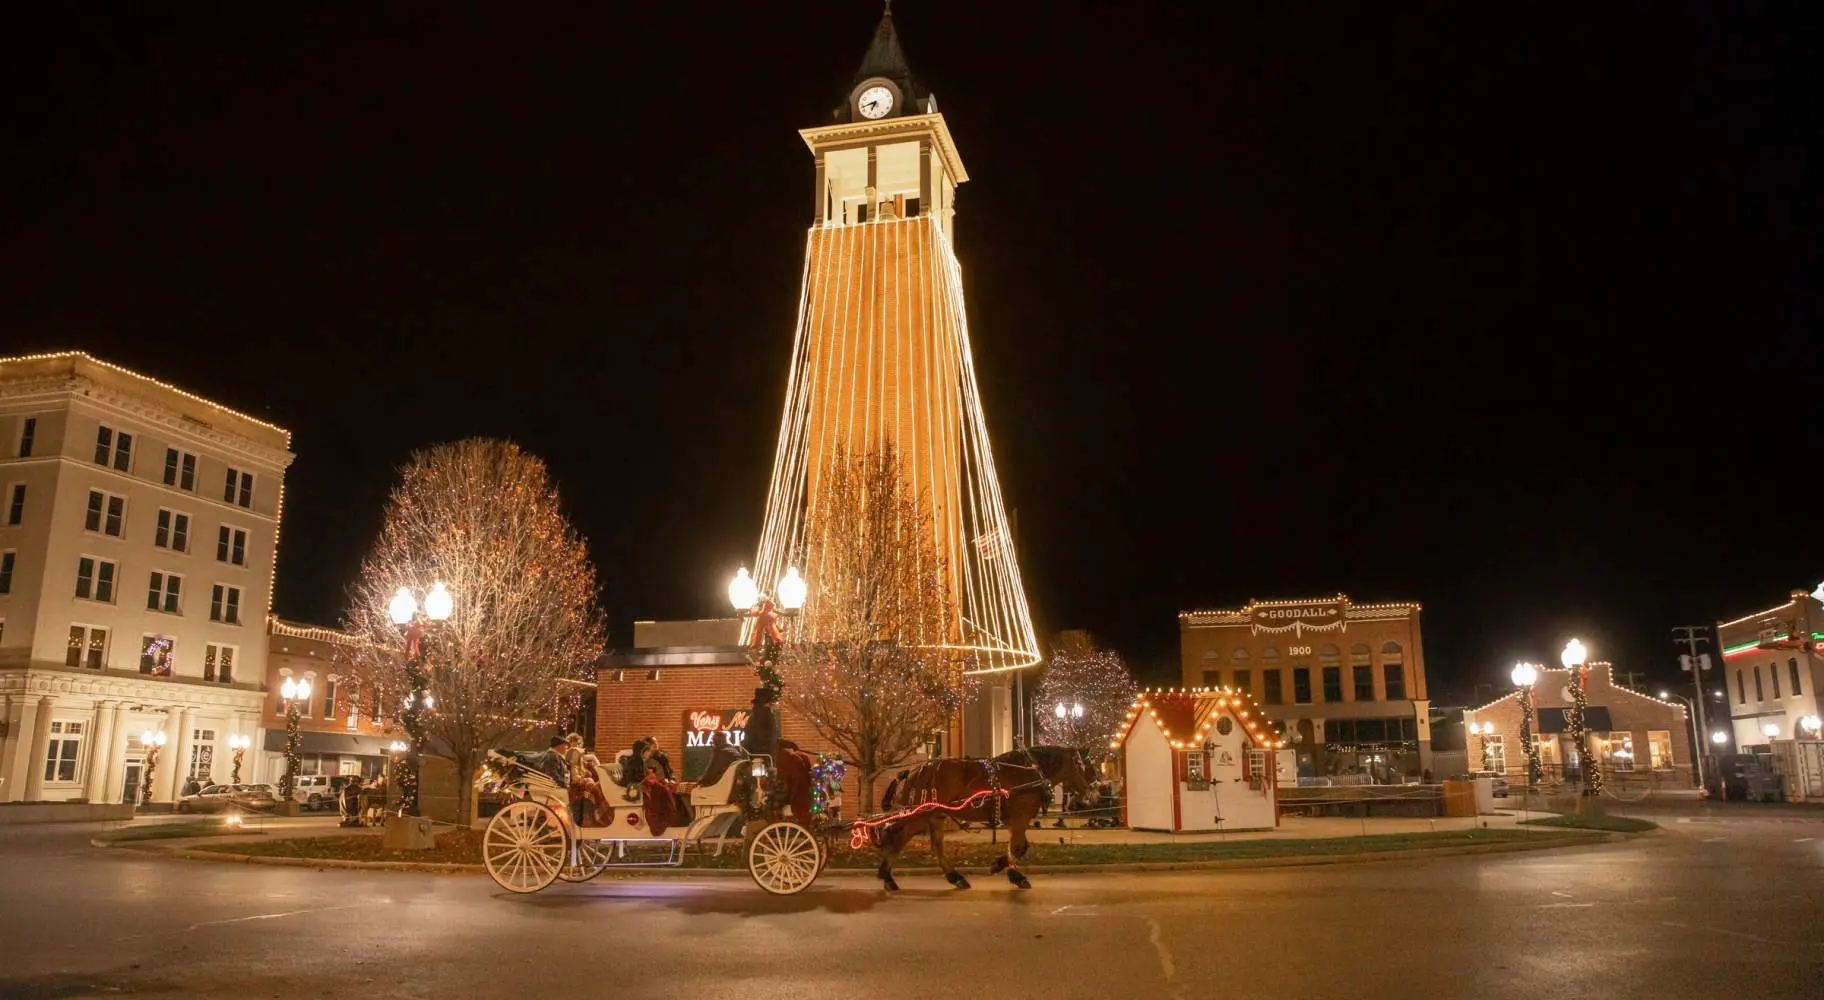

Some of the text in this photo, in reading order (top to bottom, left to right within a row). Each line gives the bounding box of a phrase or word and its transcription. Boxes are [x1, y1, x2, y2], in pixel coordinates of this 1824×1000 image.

[1269, 607, 1326, 619] GOODALL
[1288, 646, 1312, 656] 1900
[690, 710, 720, 731] Very
